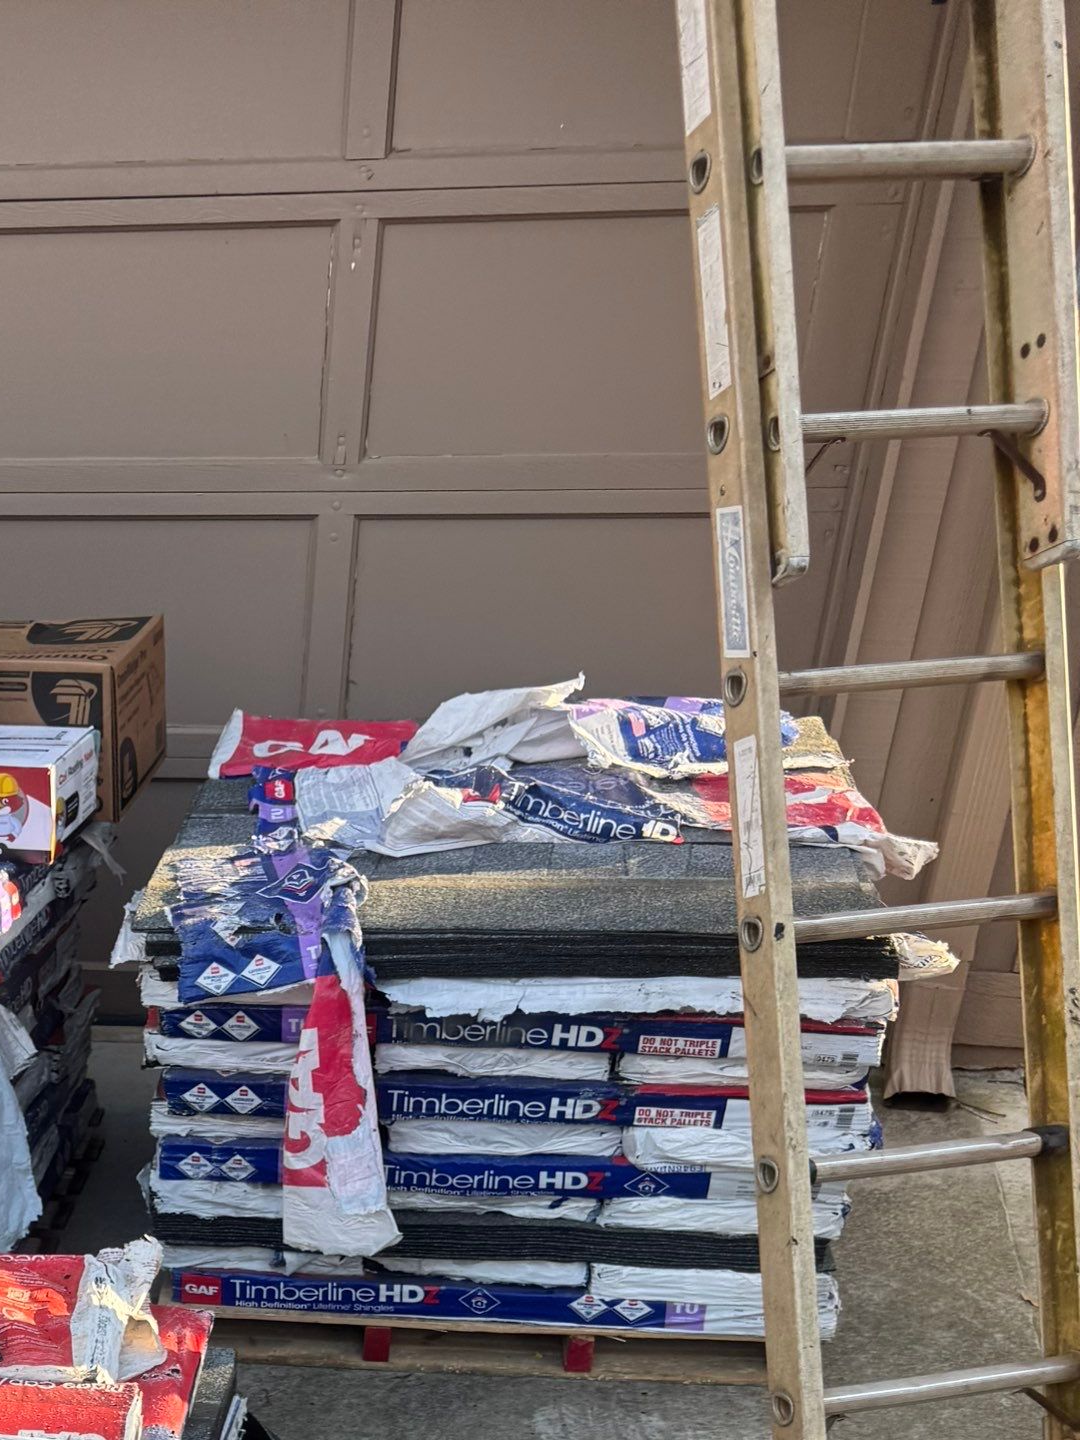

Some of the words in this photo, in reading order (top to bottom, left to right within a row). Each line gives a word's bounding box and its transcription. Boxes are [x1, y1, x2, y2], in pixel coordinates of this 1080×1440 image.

[642, 1036, 656, 1045] DO
[660, 1037, 680, 1047] NOT
[683, 1039, 718, 1049] TRIPLE
[640, 1046, 673, 1054] STACK
[674, 1048, 716, 1057] PALLETS
[638, 1108, 651, 1117] DO
[655, 1109, 675, 1118] NOT
[680, 1111, 713, 1119] TRIPLE
[637, 1117, 669, 1125] STACK
[671, 1119, 711, 1127] PALLETS
[184, 1283, 219, 1296] GAF
[235, 1300, 259, 1309] High
[353, 1303, 395, 1312] Shingles
[673, 1302, 699, 1315] TU
